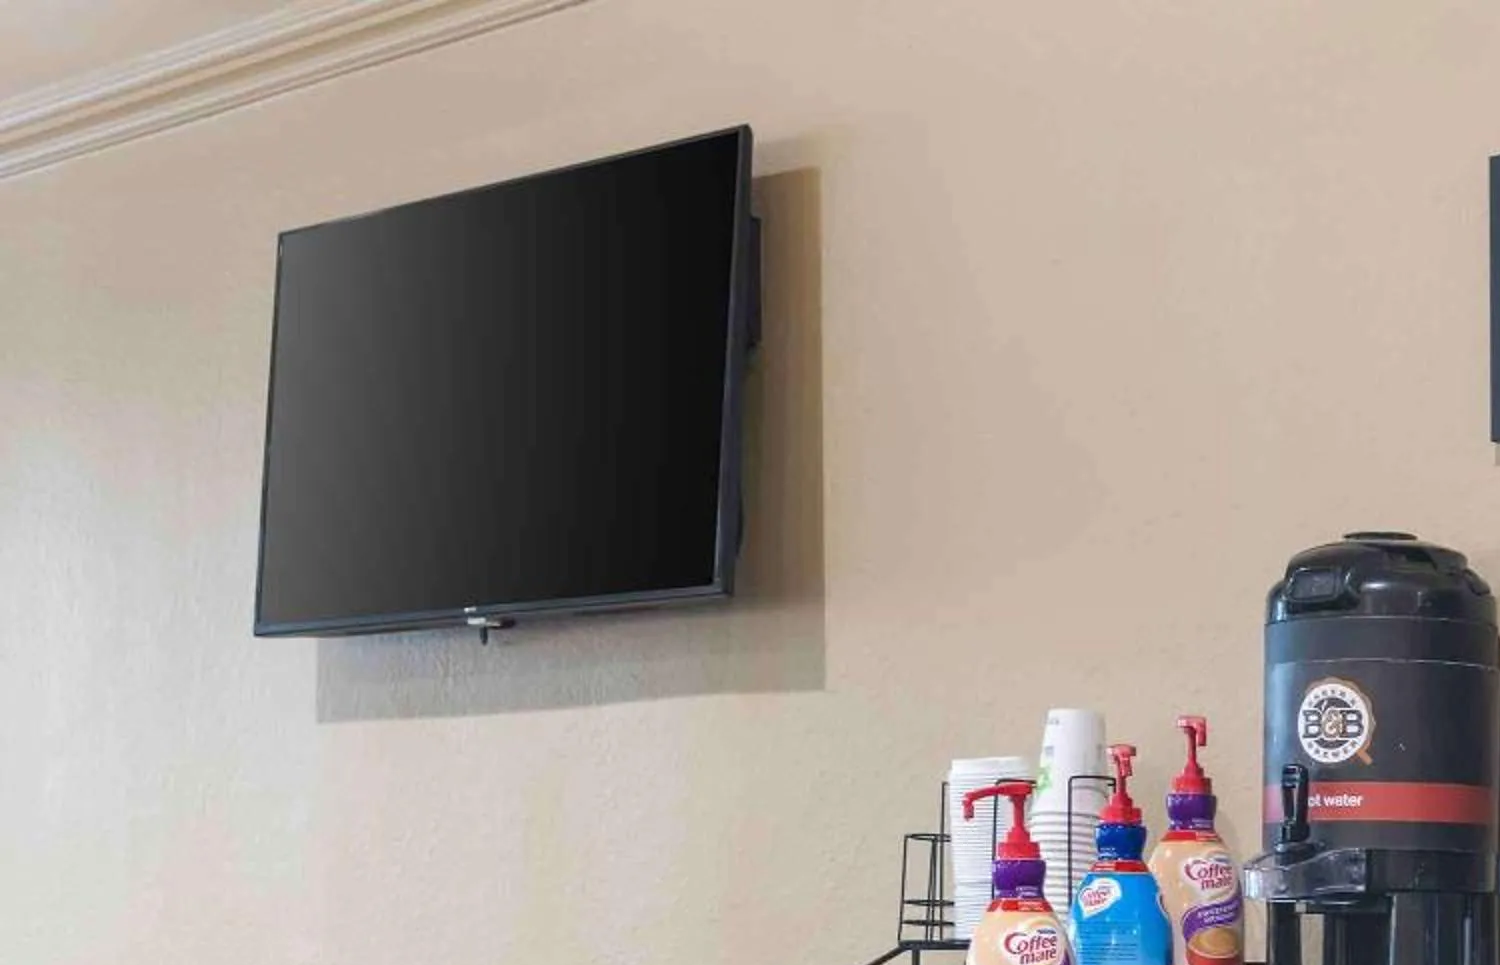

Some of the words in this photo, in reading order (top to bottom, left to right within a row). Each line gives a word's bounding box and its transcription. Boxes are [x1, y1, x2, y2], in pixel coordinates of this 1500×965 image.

[1308, 794, 1321, 807] ot
[1323, 794, 1363, 807] water
[1004, 932, 1057, 954] Coffee
[1020, 949, 1057, 965] mate
